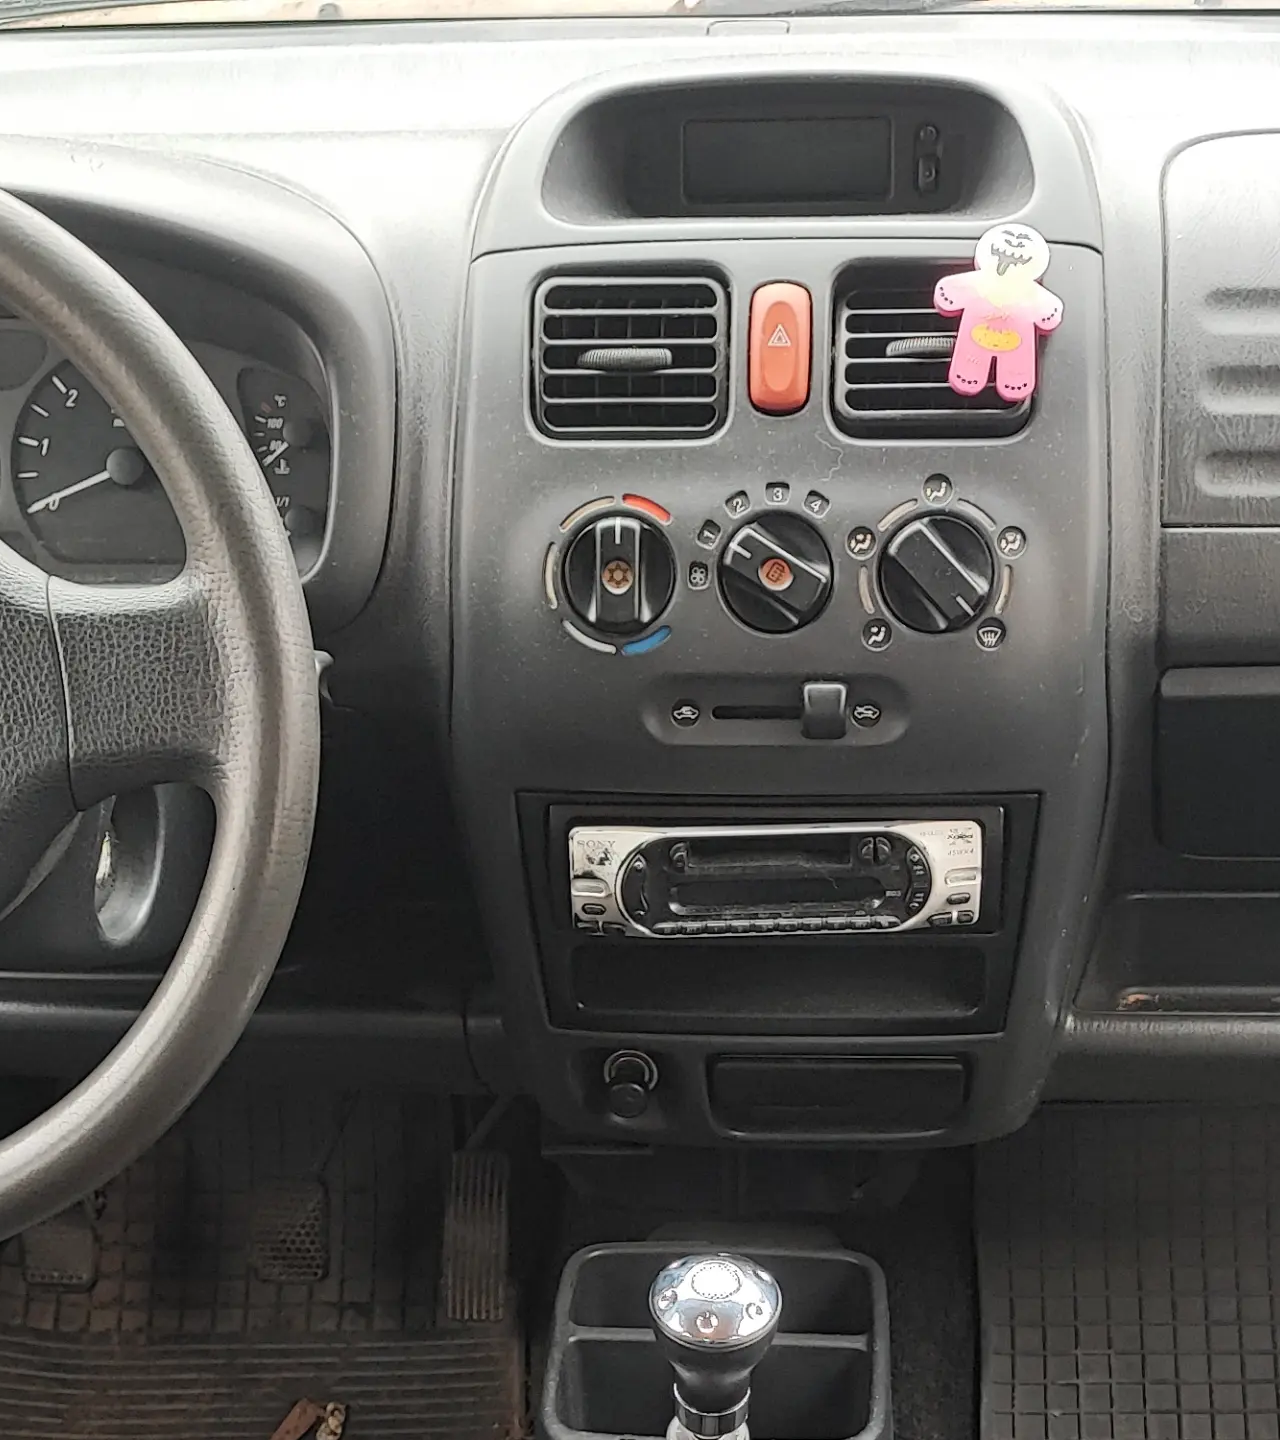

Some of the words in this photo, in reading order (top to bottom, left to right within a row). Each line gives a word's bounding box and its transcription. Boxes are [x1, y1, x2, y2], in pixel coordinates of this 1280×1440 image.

[65, 388, 78, 407] 2
[41, 437, 50, 456] 1
[772, 487, 783, 501] 3
[732, 498, 745, 513] 2
[810, 499, 822, 513] 4
[703, 529, 716, 541] 1
[576, 840, 616, 849] SONY
